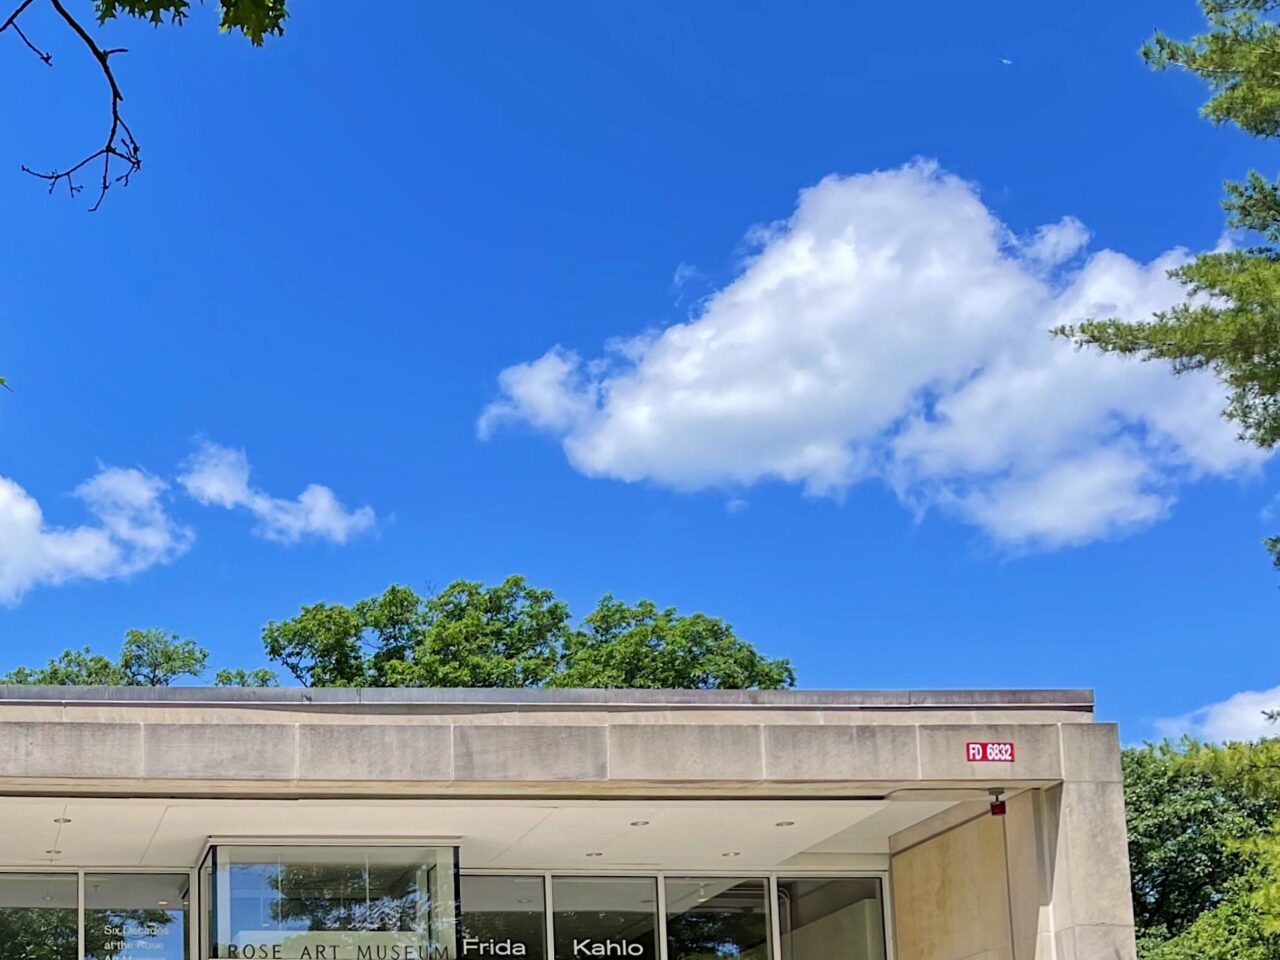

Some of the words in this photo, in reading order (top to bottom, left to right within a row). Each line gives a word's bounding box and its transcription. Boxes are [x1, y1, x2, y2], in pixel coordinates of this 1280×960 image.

[969, 744, 983, 760] FD
[986, 744, 1012, 760] 6832
[104, 925, 121, 935] Six
[123, 925, 169, 936] Decades
[104, 942, 114, 950] at
[116, 940, 133, 950] the
[137, 941, 164, 950] Rose
[228, 944, 282, 960] ROSE
[300, 945, 340, 960] ART
[357, 945, 449, 960] MUSEUM
[462, 939, 526, 956] Frida
[573, 939, 644, 956] Kahlo
